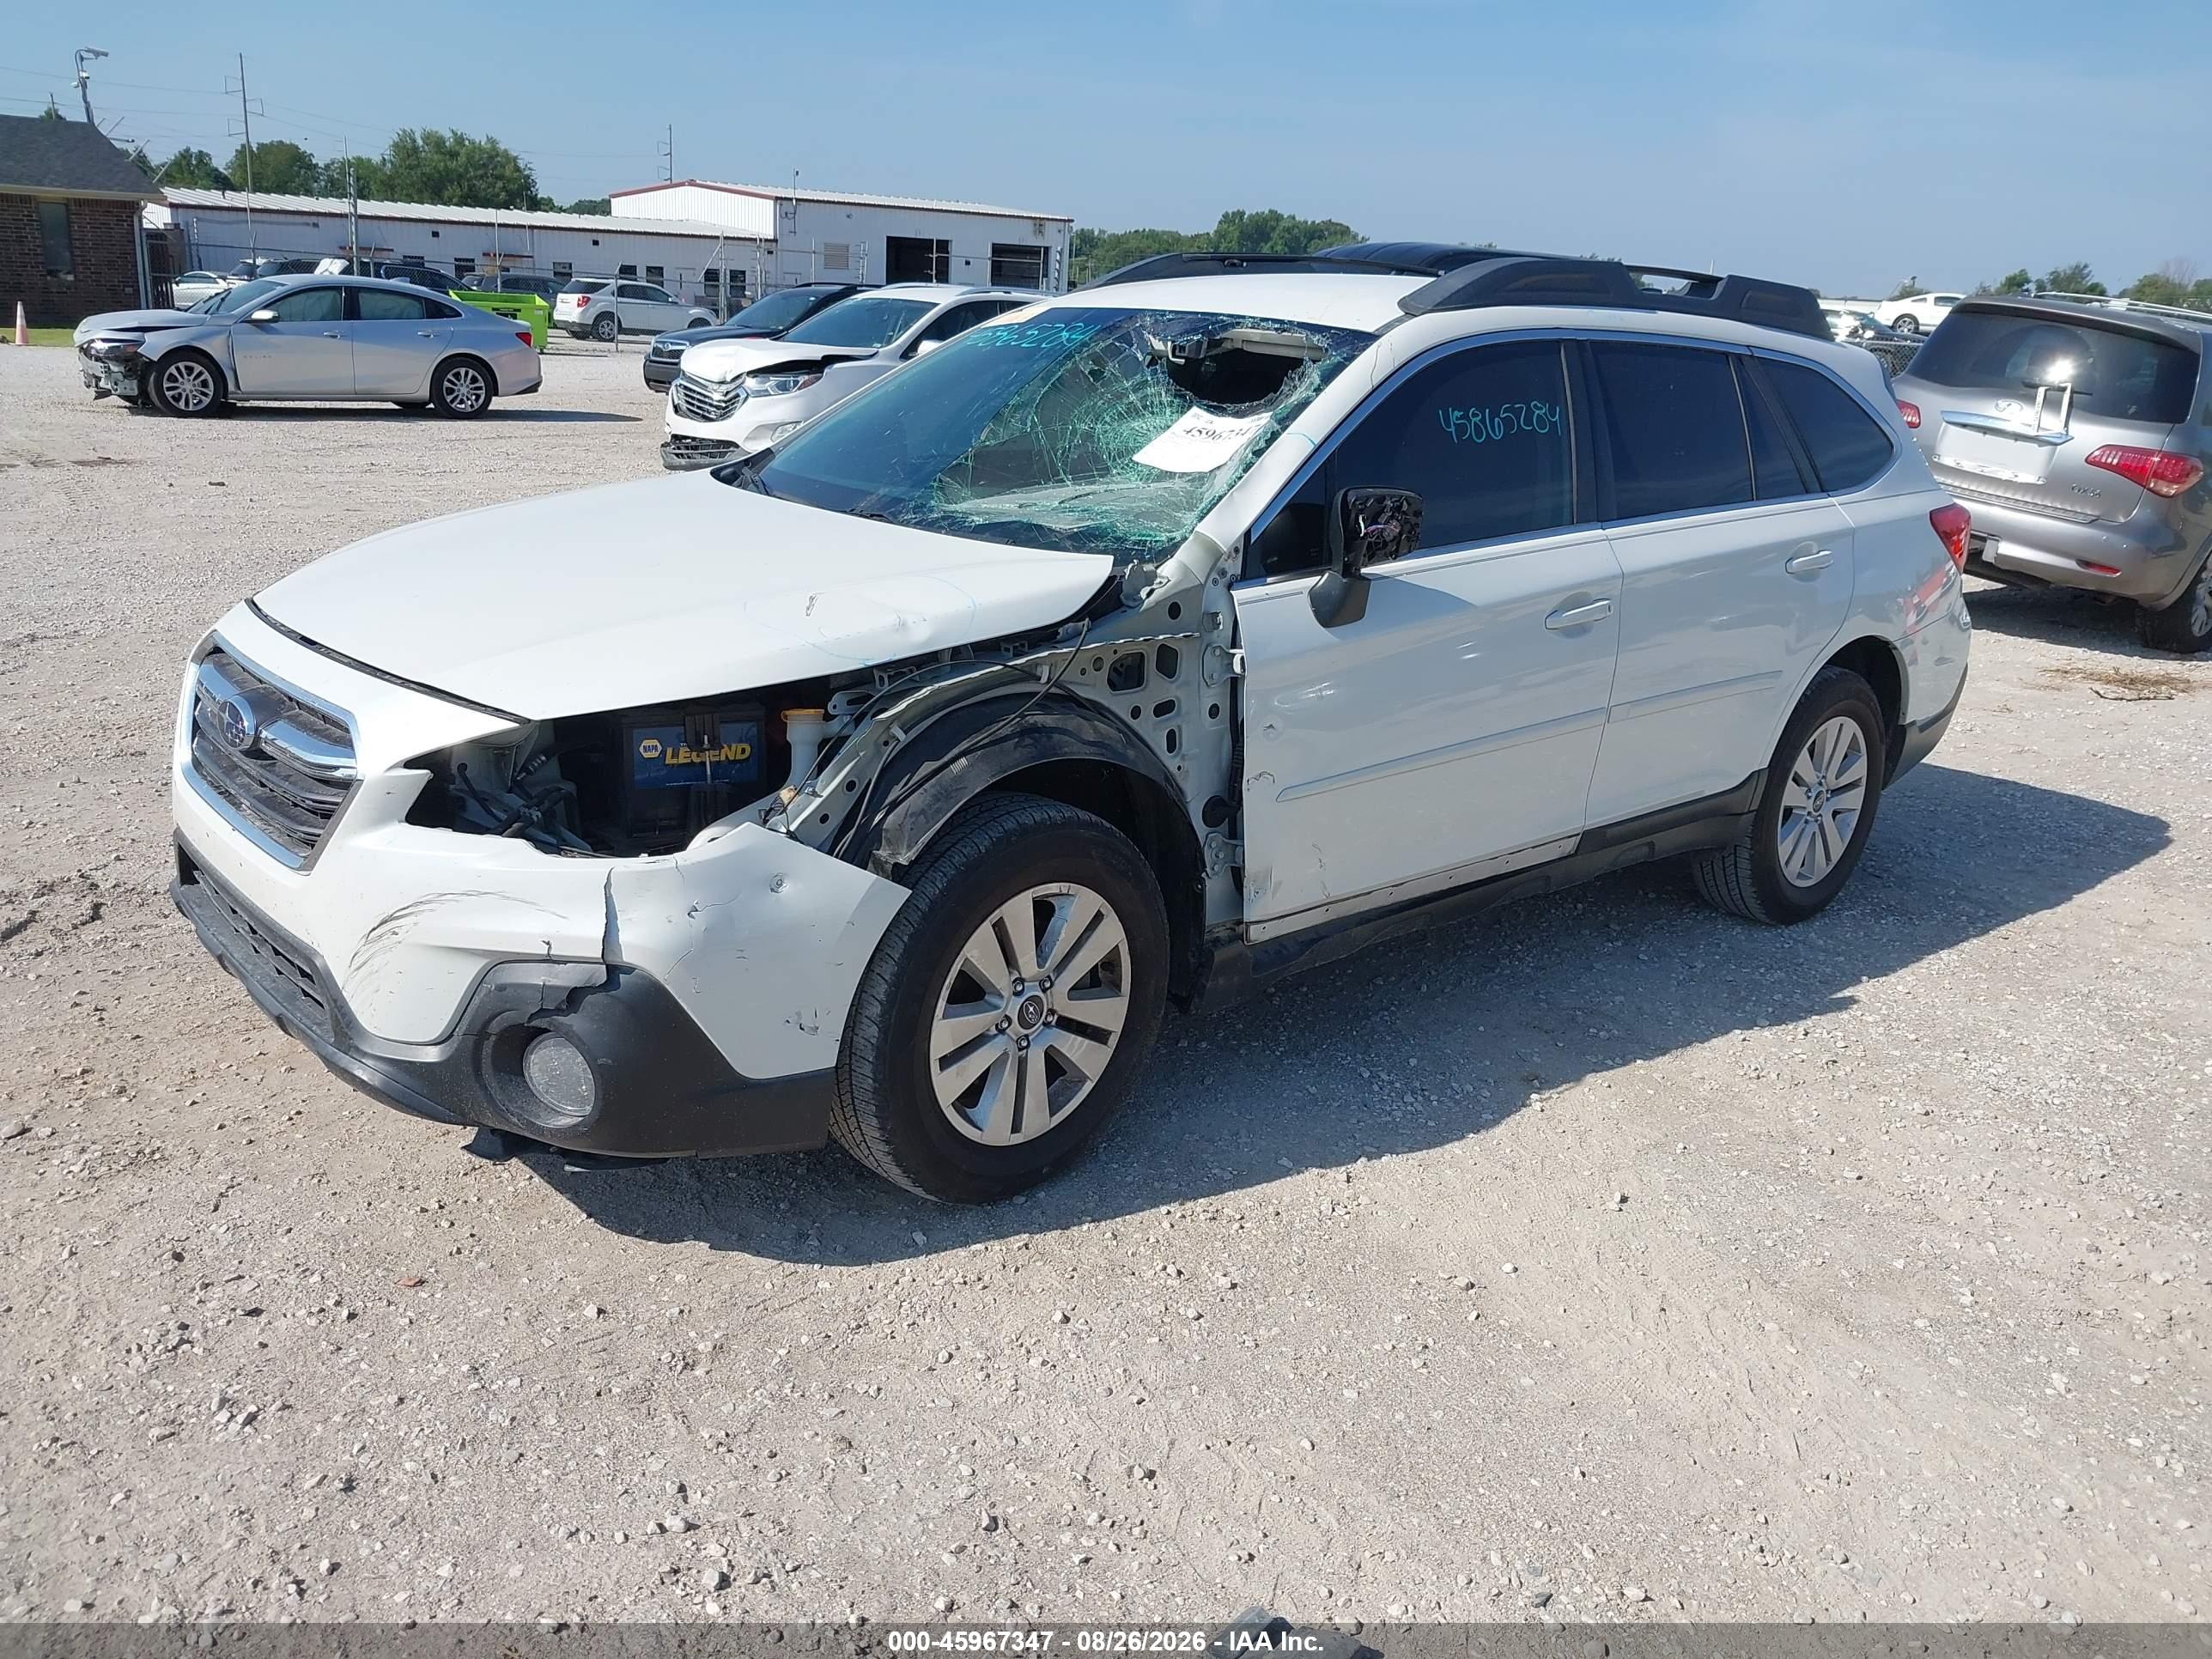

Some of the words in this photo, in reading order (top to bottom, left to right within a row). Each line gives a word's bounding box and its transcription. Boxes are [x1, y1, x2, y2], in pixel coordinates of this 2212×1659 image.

[1438, 400, 1562, 444] 45865284
[642, 744, 659, 753] NAPA
[665, 744, 751, 765] LEGEND
